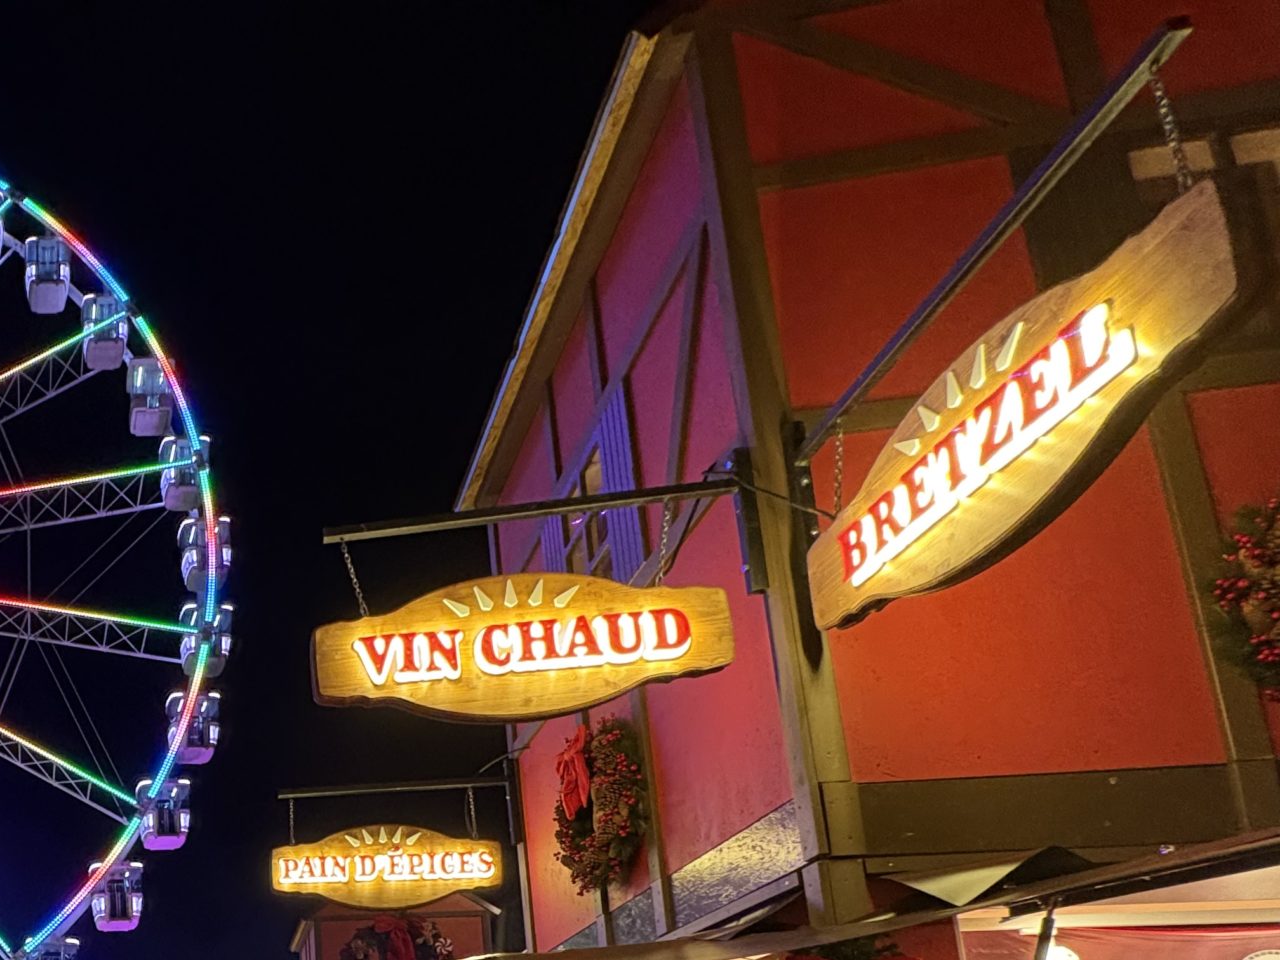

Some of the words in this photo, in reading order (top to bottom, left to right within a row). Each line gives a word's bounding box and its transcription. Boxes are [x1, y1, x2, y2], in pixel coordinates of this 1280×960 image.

[838, 301, 1137, 586] BRETZEL
[354, 629, 463, 684] VIN
[474, 608, 692, 675] CHAUD
[280, 856, 349, 882] PAIN
